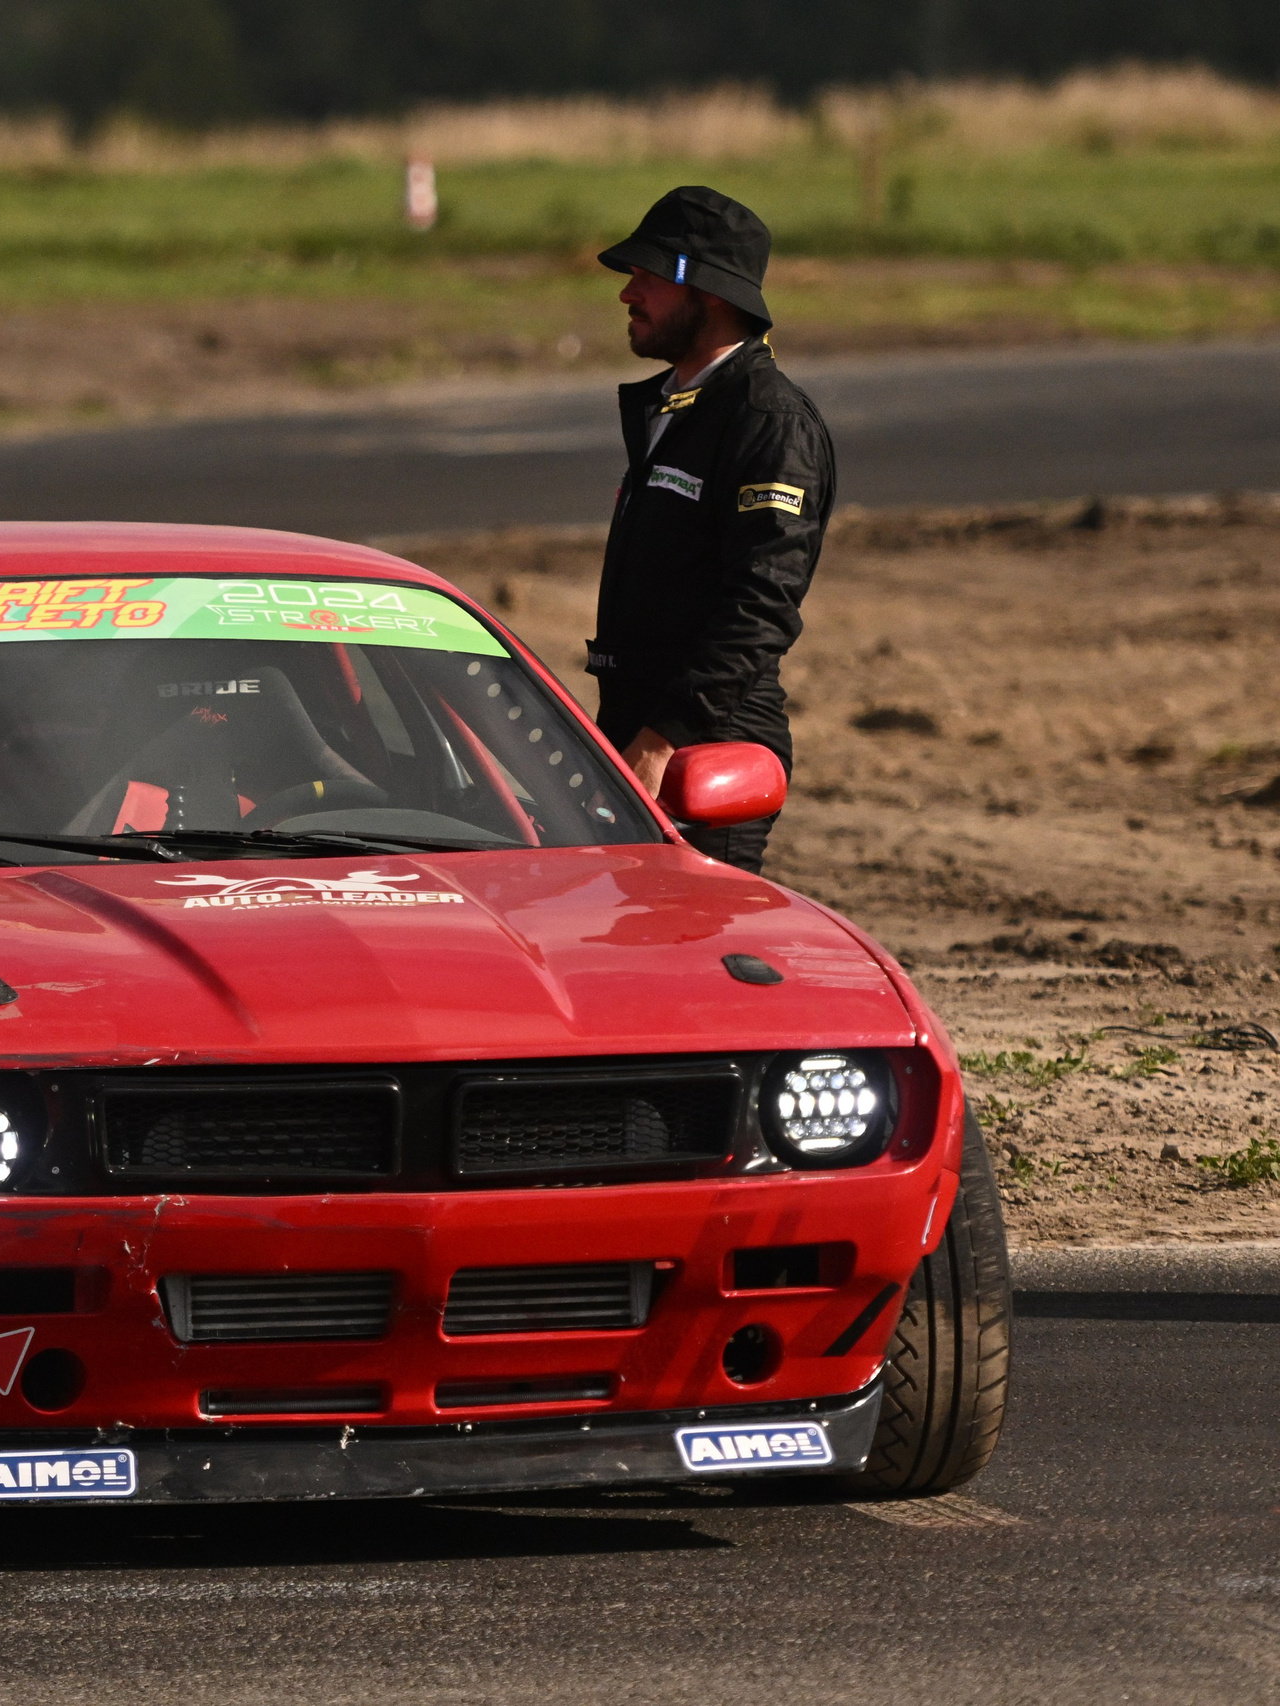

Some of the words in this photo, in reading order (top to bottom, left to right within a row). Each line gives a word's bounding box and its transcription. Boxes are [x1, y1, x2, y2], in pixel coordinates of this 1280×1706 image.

[219, 582, 408, 613] 2024
[157, 678, 261, 698] BRIDE
[183, 892, 283, 909] AUTO
[321, 891, 465, 904] LEADER
[690, 1432, 824, 1462] AIMOL
